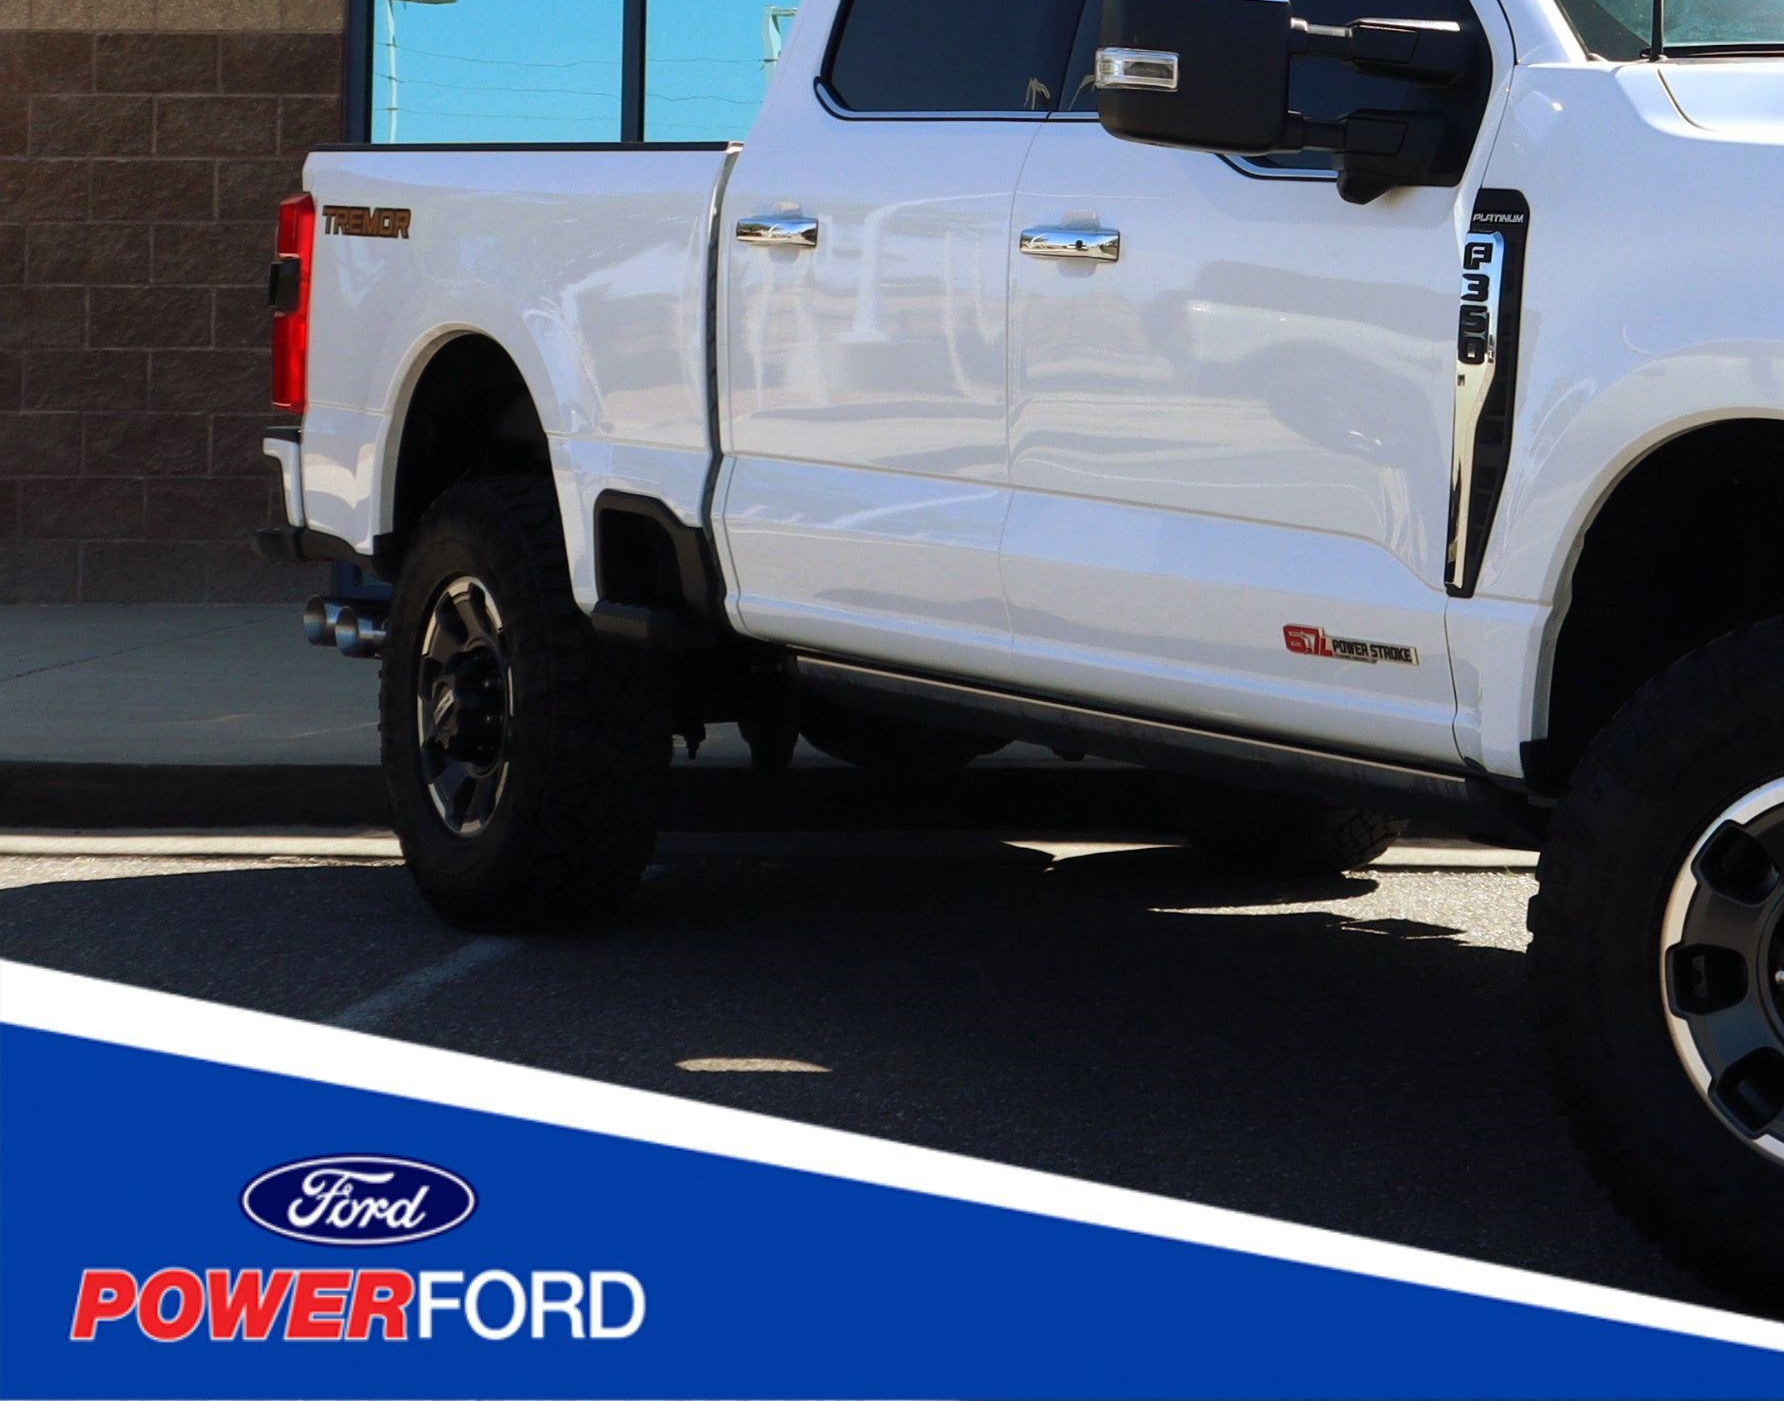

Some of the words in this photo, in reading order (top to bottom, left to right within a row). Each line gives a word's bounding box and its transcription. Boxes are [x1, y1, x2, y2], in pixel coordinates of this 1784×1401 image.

[323, 204, 411, 239] TREMOR
[1472, 213, 1525, 224] PLATINUM
[1331, 638, 1370, 657] POWER
[1369, 643, 1413, 662] STROKE
